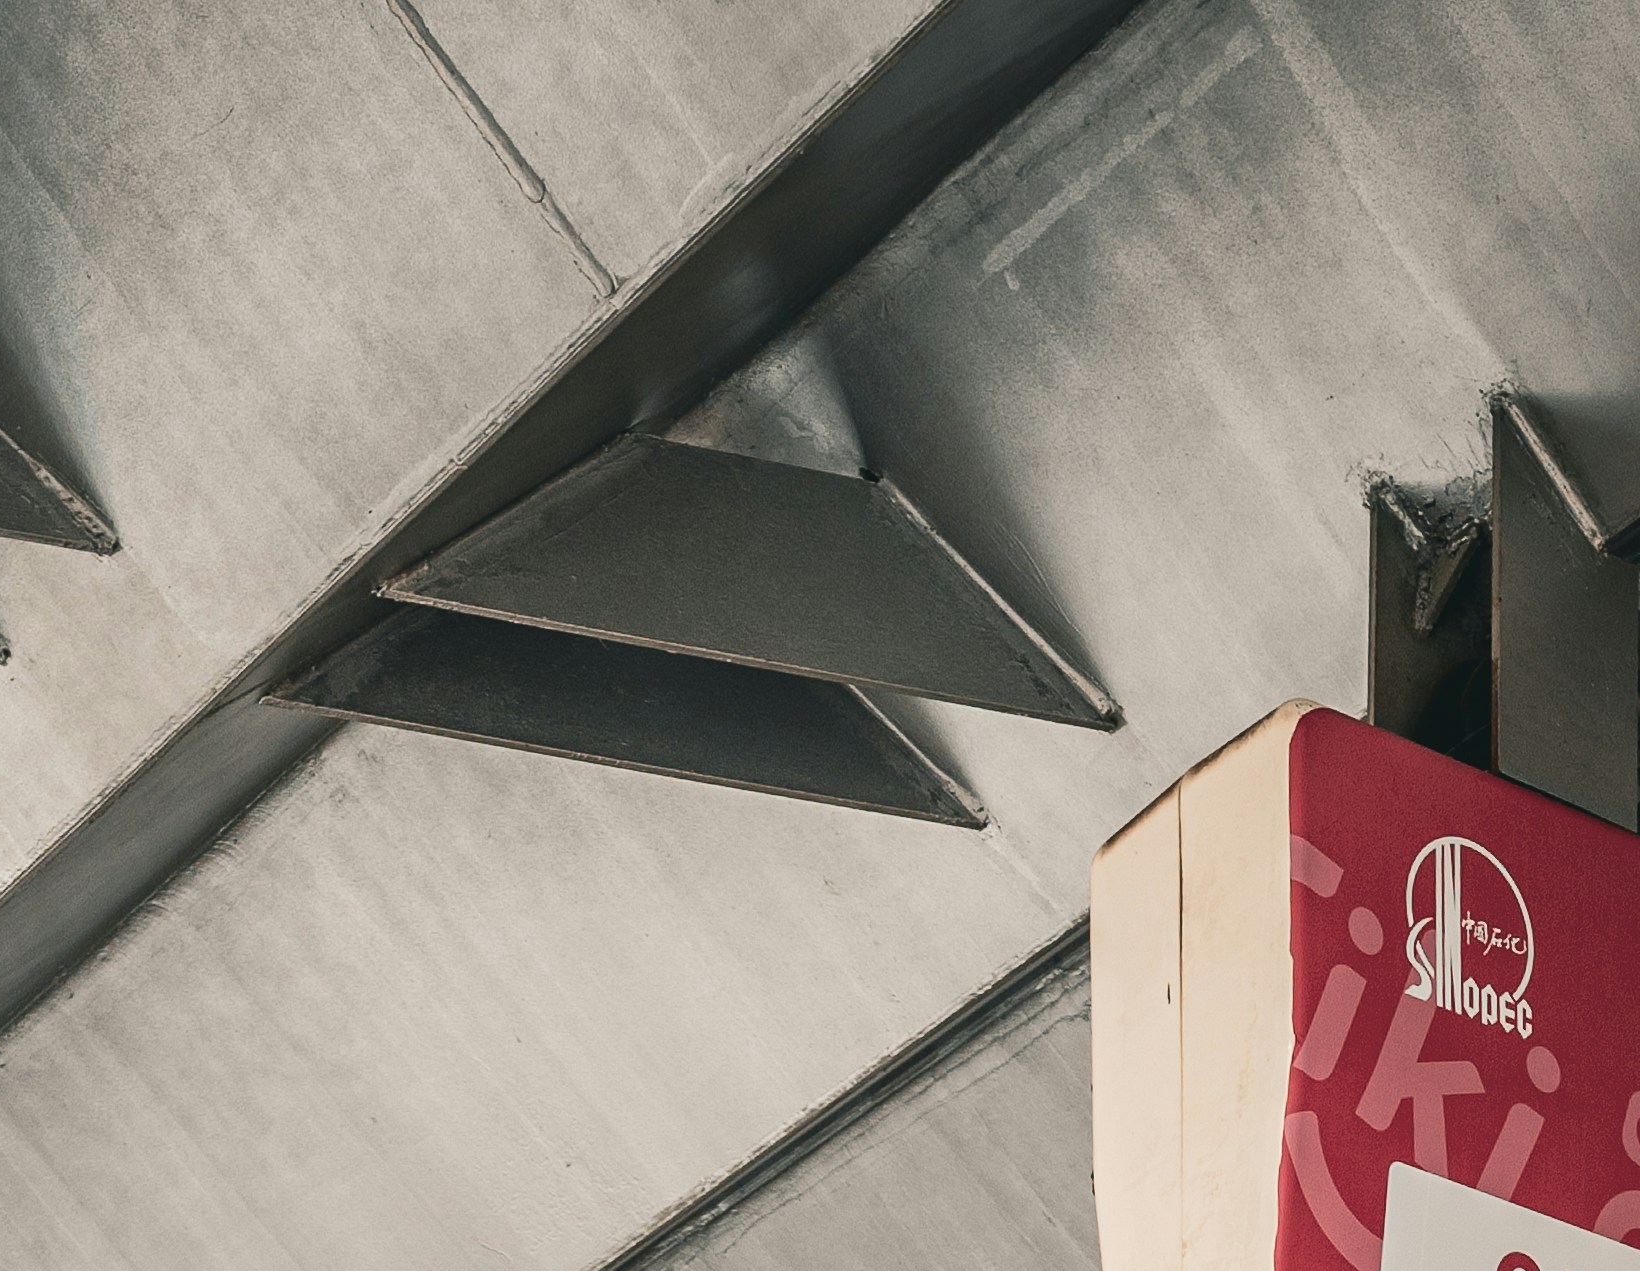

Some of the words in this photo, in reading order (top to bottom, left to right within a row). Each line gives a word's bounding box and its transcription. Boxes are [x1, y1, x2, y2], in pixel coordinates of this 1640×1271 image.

[1289, 834, 1561, 1200] iki
[1405, 838, 1533, 1040] SINOPEC
[1461, 911, 1528, 956] 中国石化
